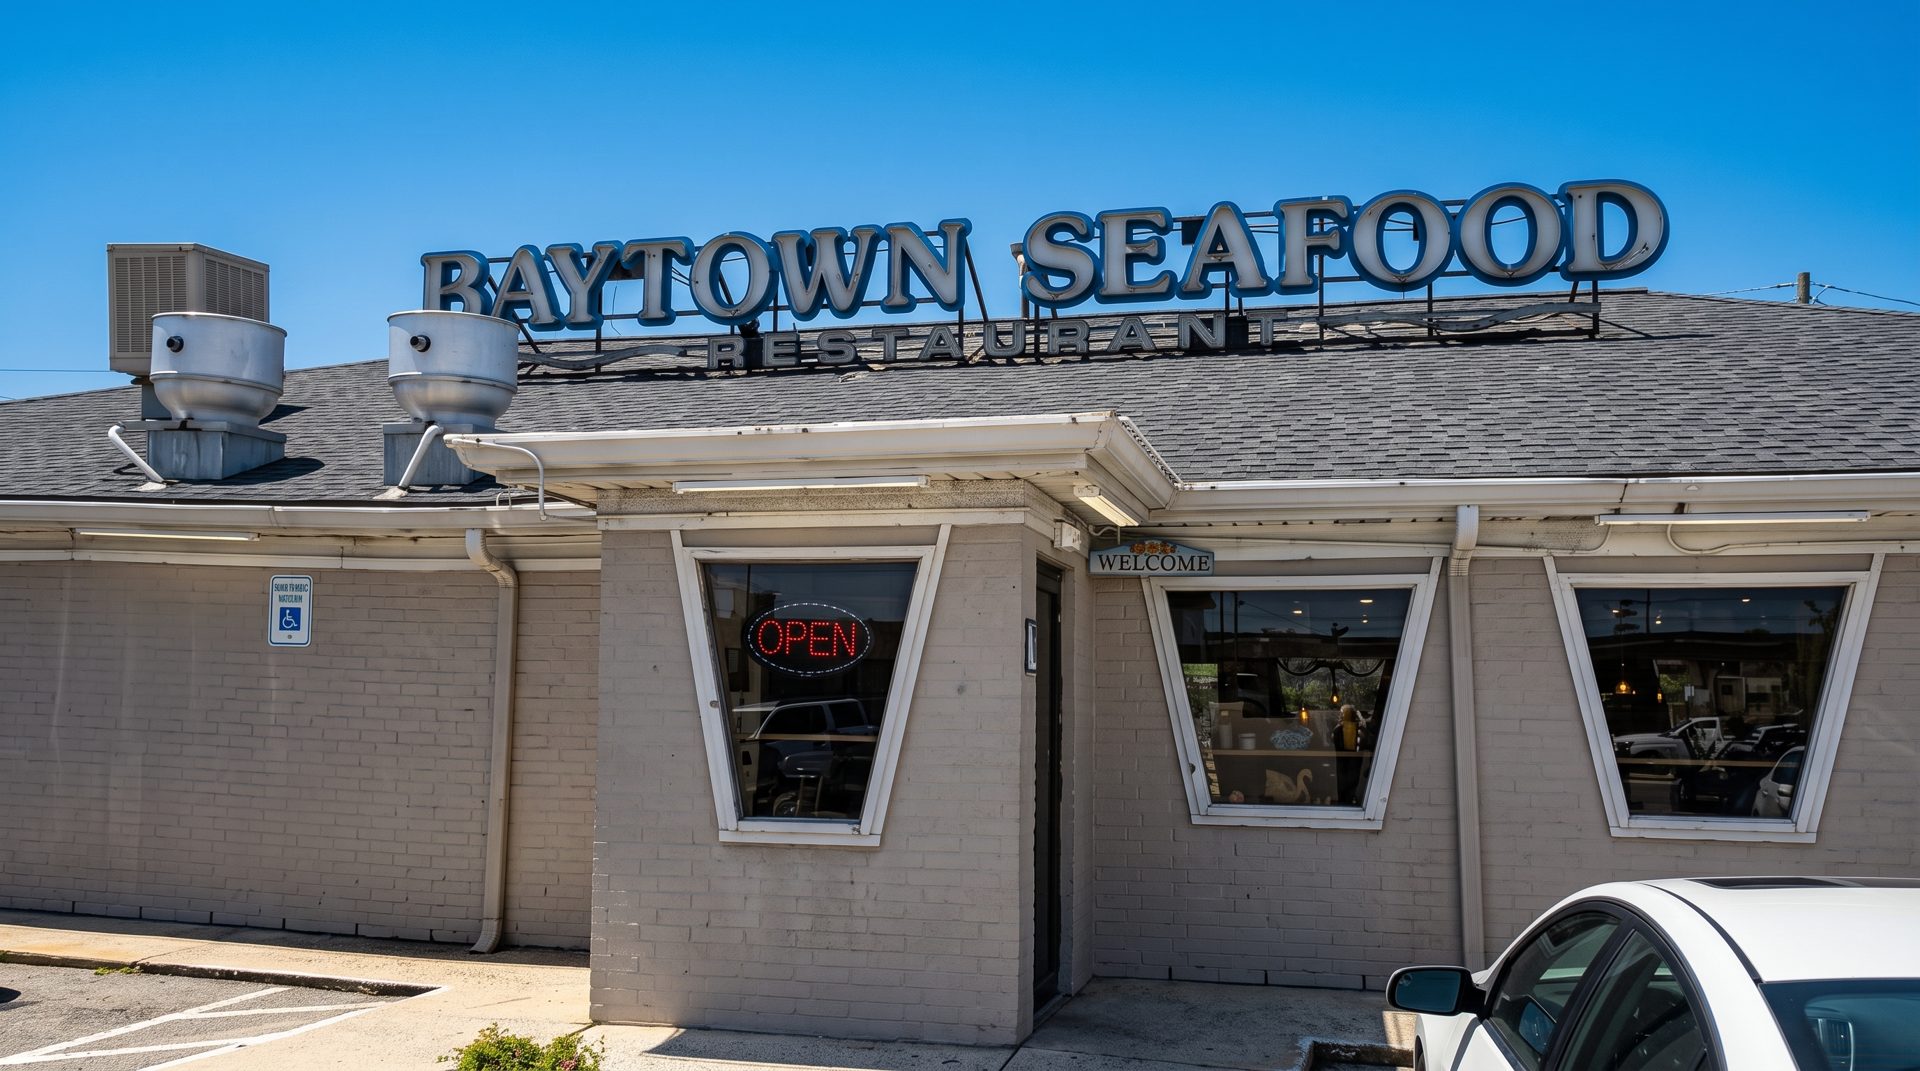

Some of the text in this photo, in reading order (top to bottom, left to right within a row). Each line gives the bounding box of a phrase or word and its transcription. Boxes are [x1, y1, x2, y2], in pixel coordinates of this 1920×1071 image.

[421, 178, 1669, 331] BAYTOWN SEAFOOD
[707, 310, 1288, 371] RESTAURANT
[1098, 554, 1210, 572] WELCOME
[757, 620, 857, 657] OPEN
